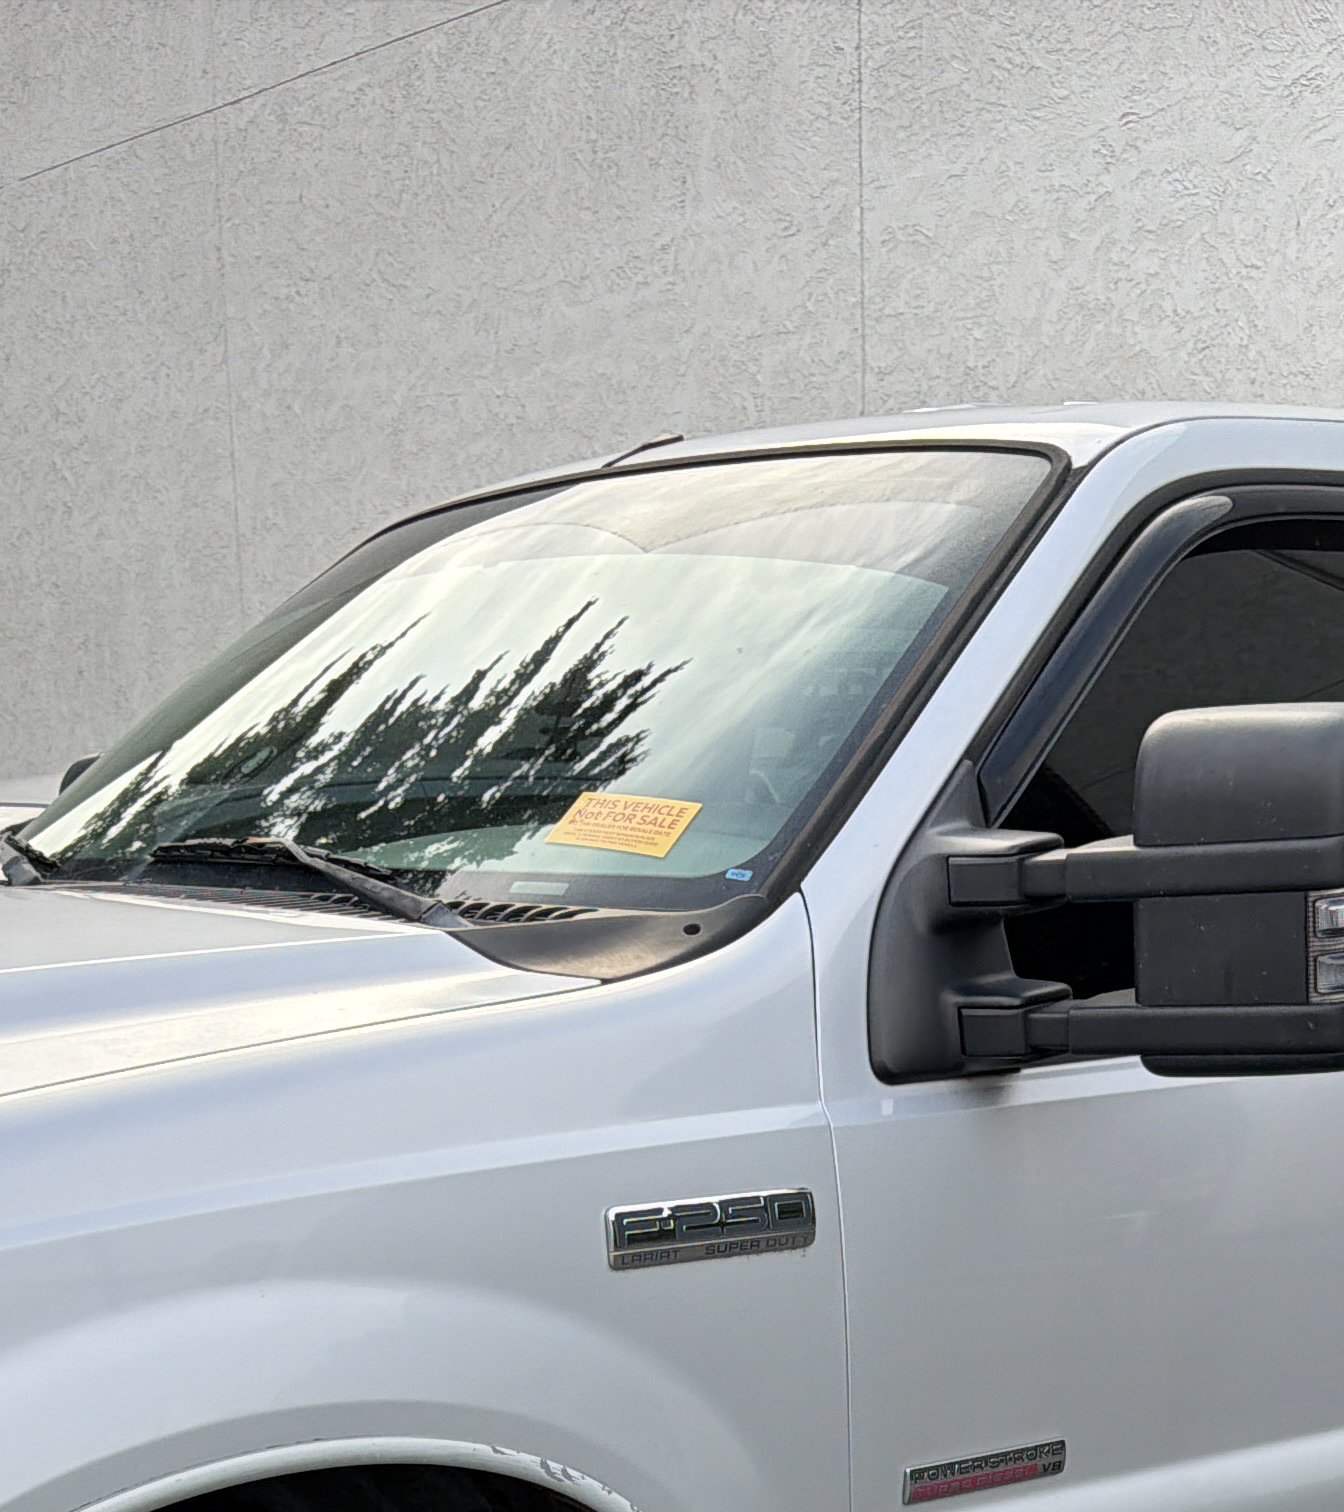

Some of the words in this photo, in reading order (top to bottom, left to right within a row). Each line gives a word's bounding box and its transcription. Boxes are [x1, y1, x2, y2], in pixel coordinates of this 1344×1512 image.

[586, 797, 620, 809] THIS
[623, 800, 689, 818] VEHICLE
[604, 810, 637, 825] FOR
[637, 815, 680, 830] SALE
[614, 1191, 814, 1249] F-250
[621, 1250, 680, 1266] LARIAT
[703, 1238, 761, 1256] SUPER
[765, 1233, 810, 1249] DUTY
[1041, 1460, 1063, 1474] V8
